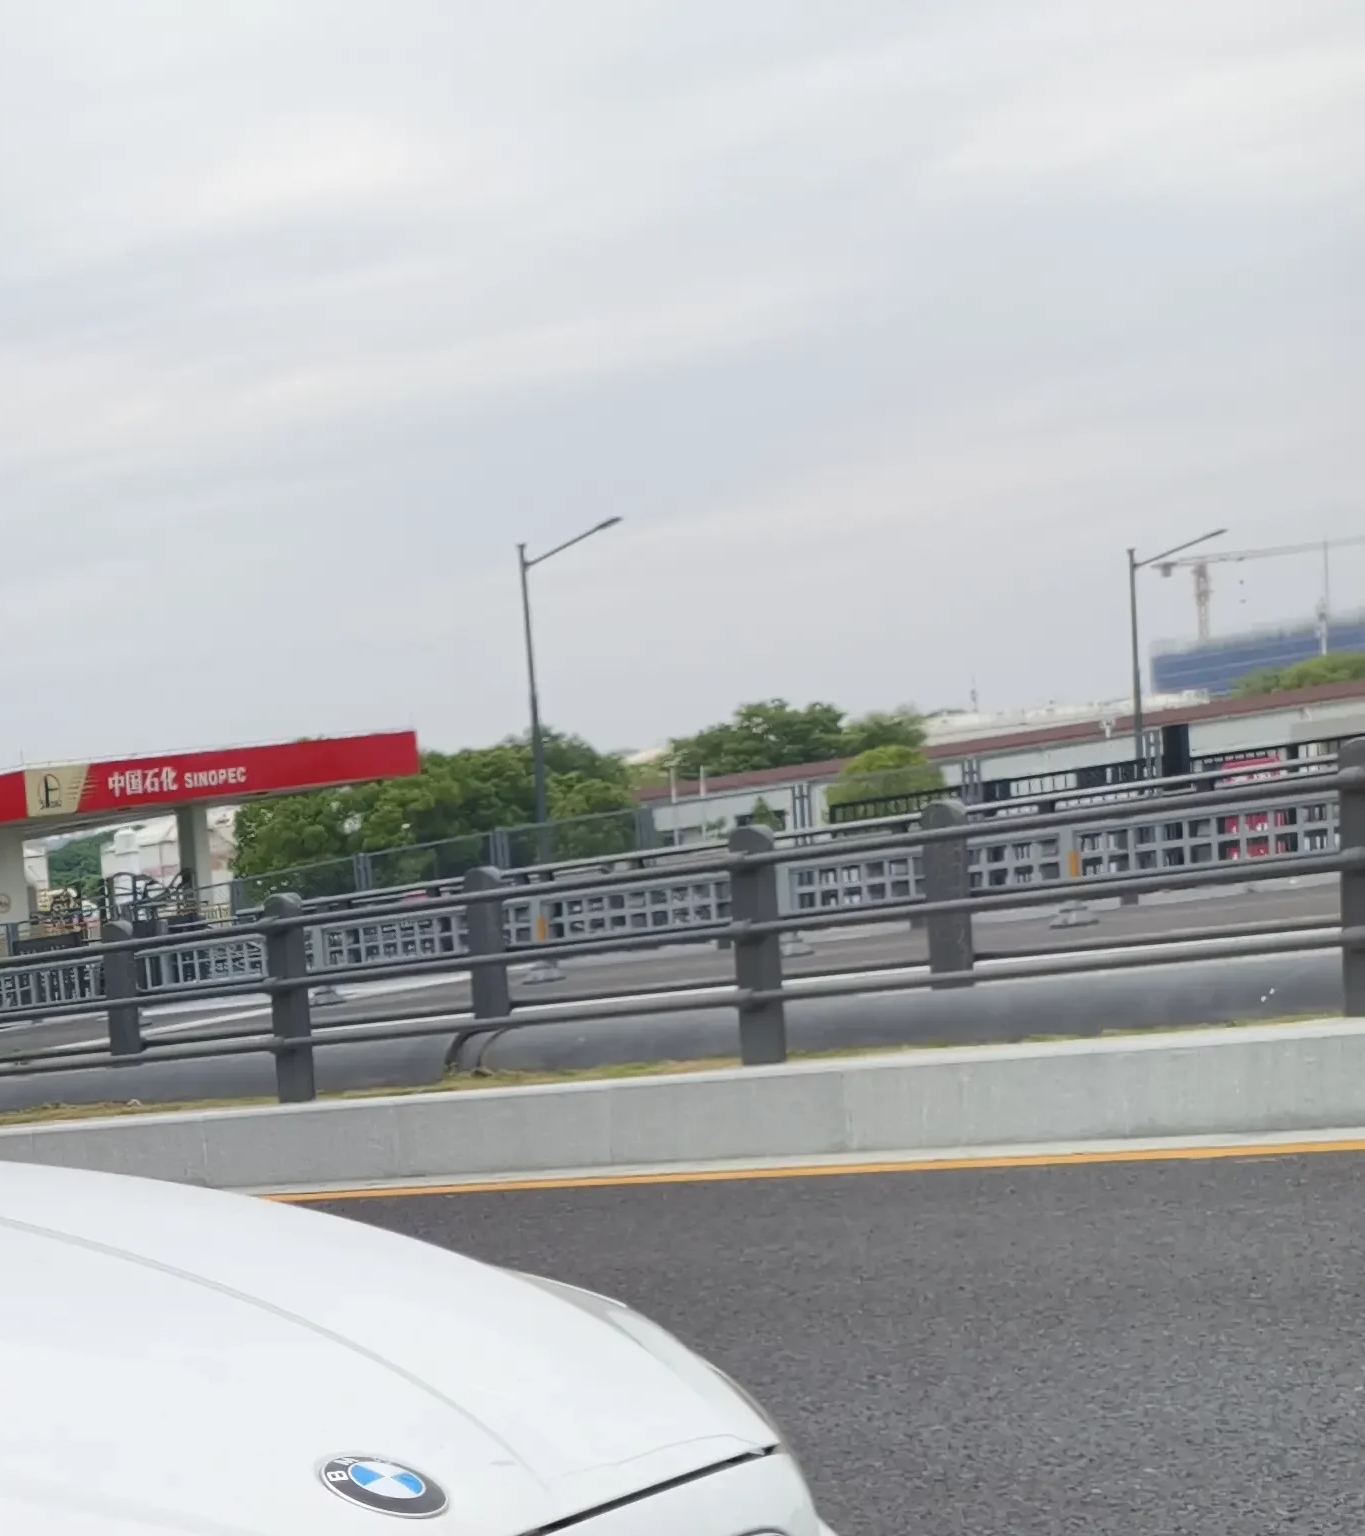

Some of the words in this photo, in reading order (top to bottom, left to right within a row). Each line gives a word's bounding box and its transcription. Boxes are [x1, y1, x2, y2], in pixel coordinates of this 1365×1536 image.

[108, 766, 179, 798] 中国石化
[184, 766, 246, 789] SINOPEC
